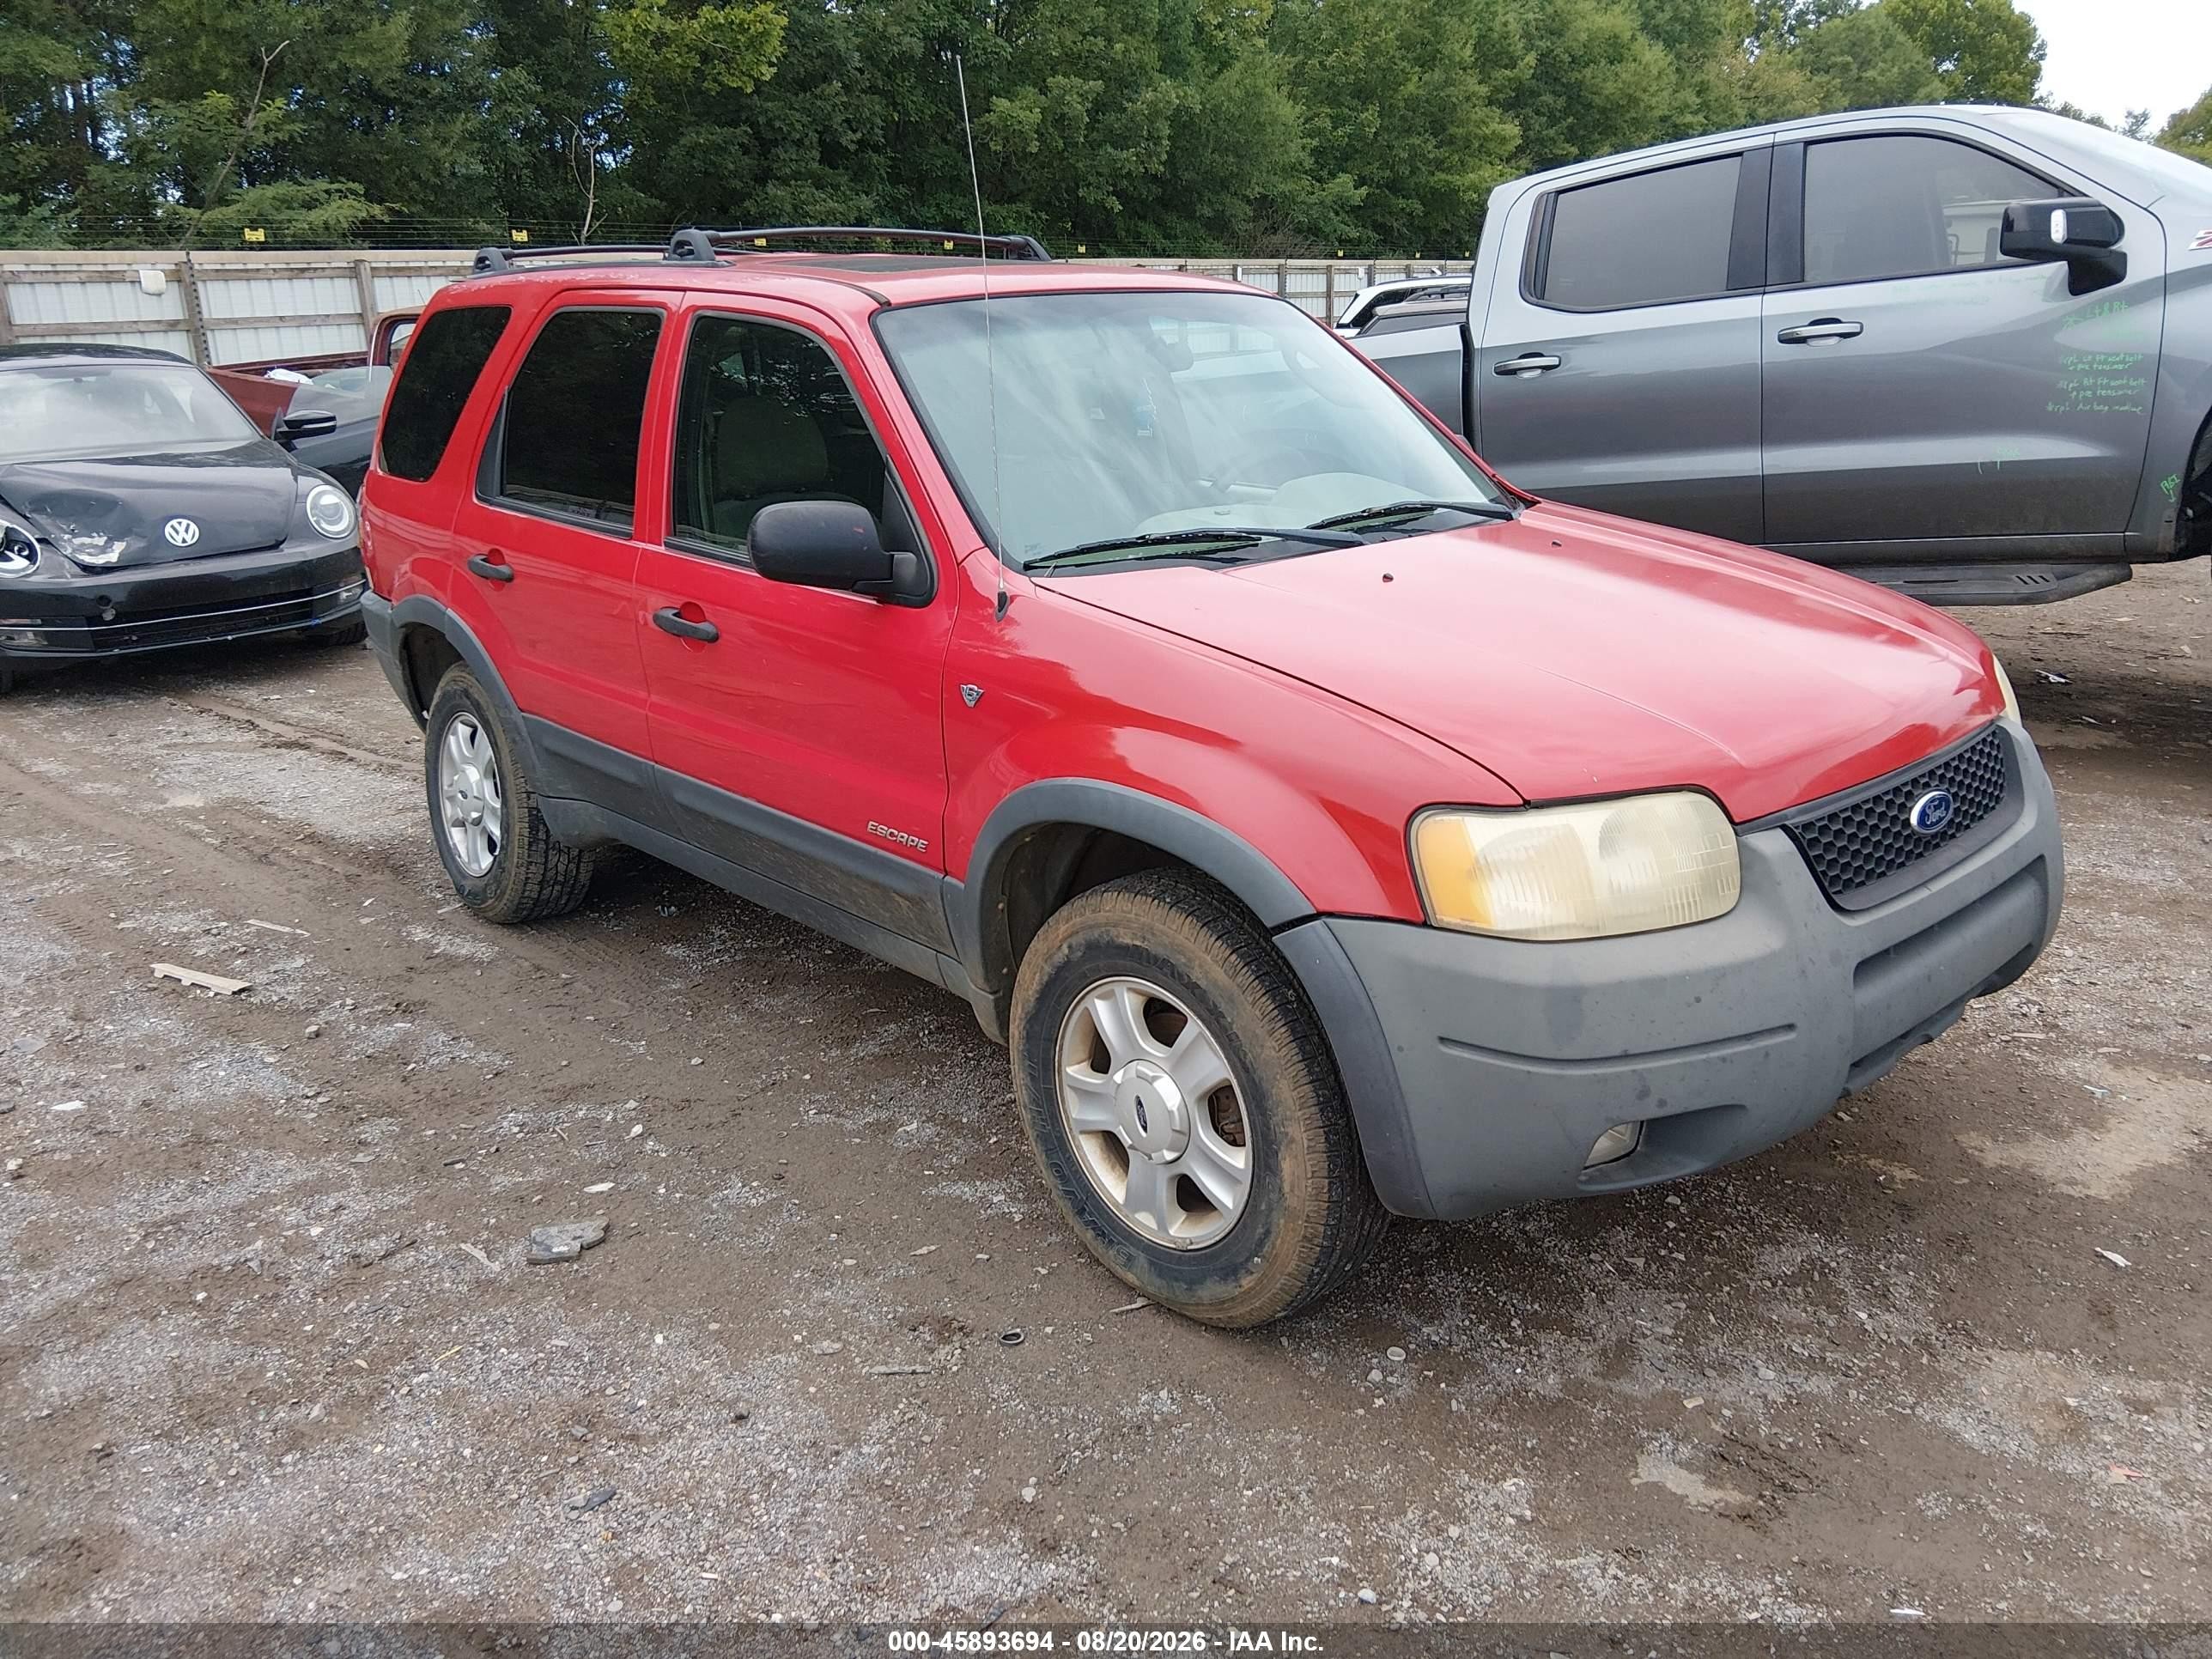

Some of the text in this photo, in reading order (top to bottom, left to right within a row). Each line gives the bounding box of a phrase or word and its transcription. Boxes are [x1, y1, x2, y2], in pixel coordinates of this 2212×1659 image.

[165, 518, 200, 547] VW
[866, 820, 929, 853] ESCAPE
[1045, 1155, 1137, 1273] BRAVO
